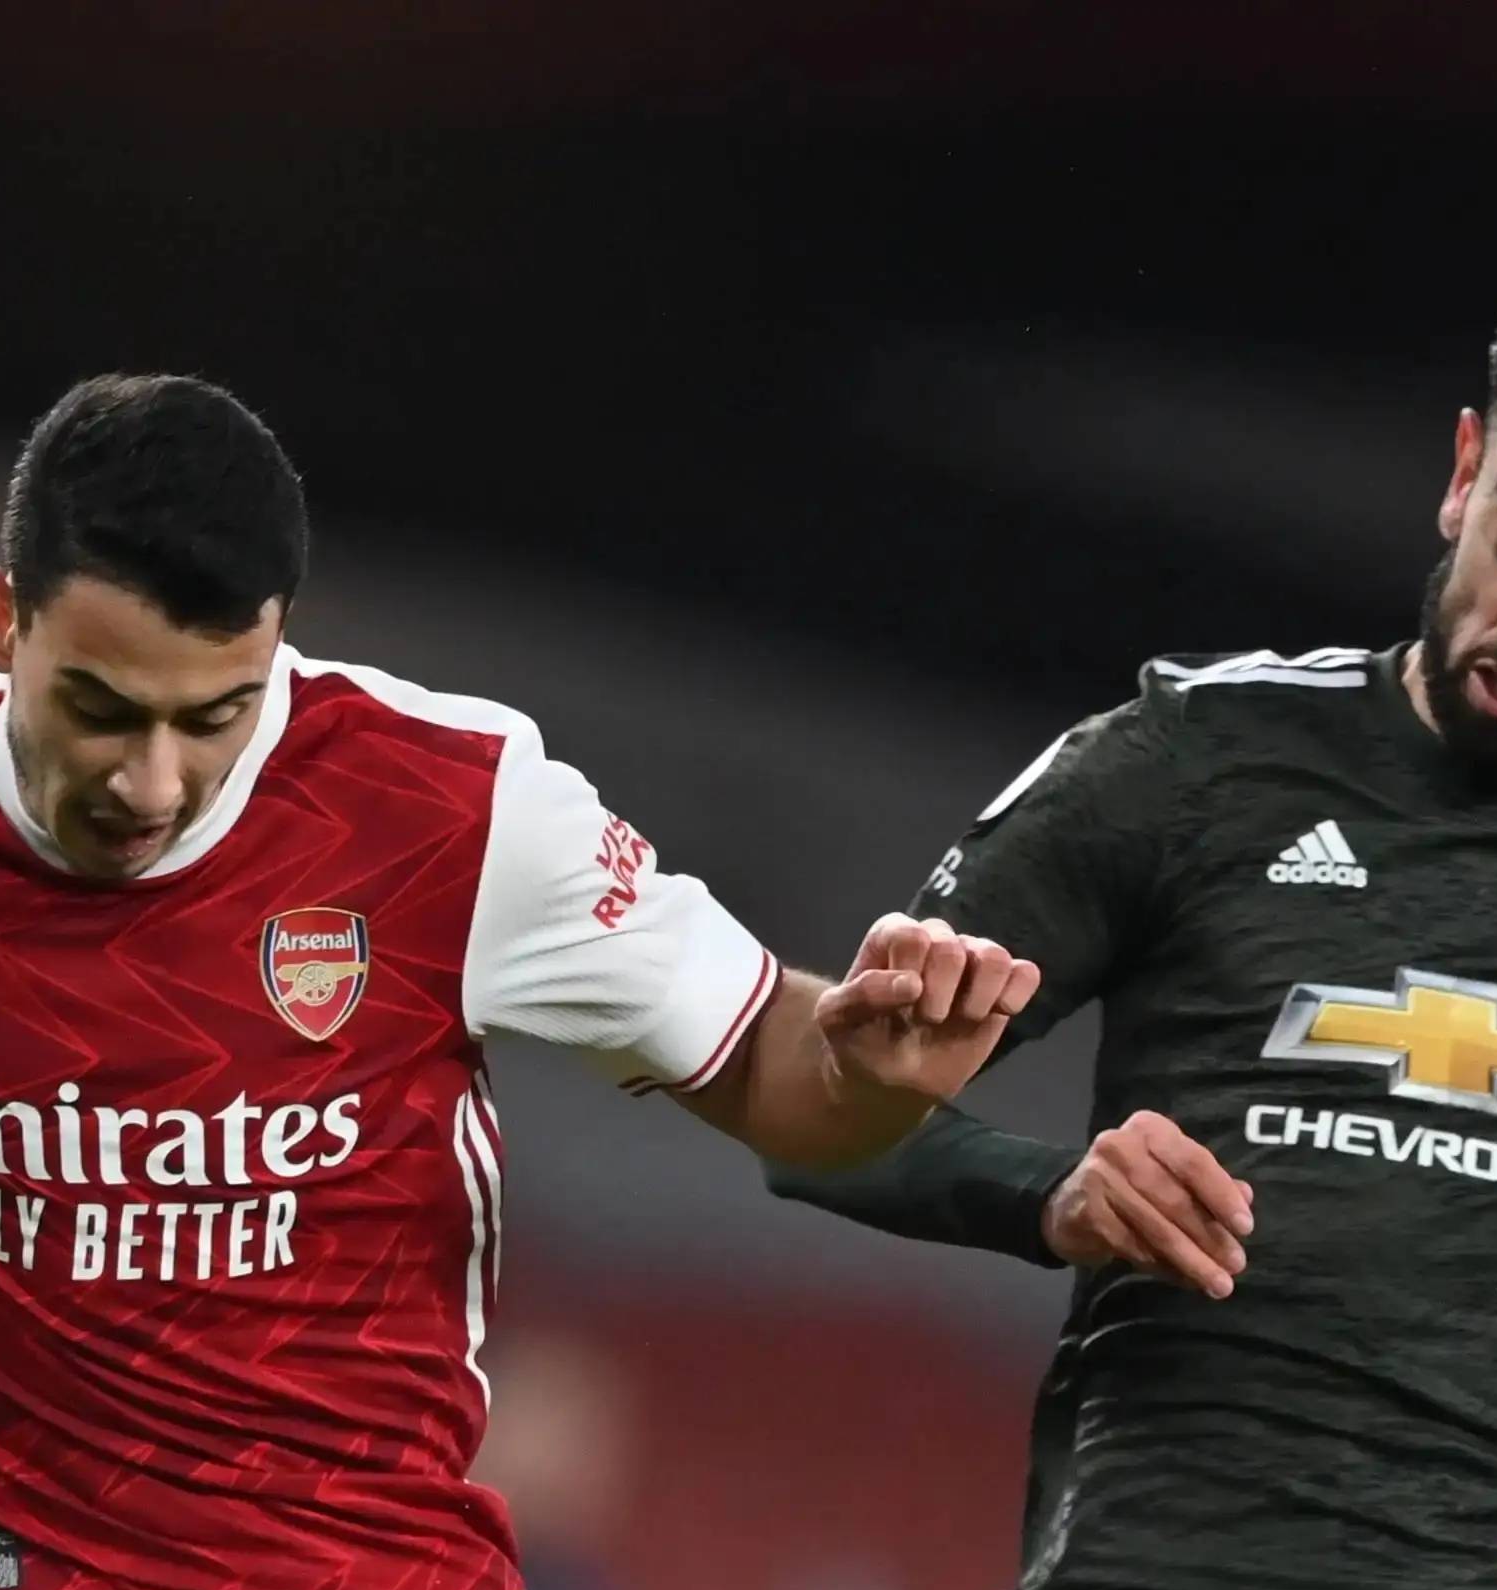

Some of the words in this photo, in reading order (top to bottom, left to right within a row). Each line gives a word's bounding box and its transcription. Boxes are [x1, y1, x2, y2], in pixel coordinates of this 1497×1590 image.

[1267, 861, 1368, 888] adidas
[275, 928, 354, 951] Arsenal
[70, 1189, 299, 1282] BETTER
